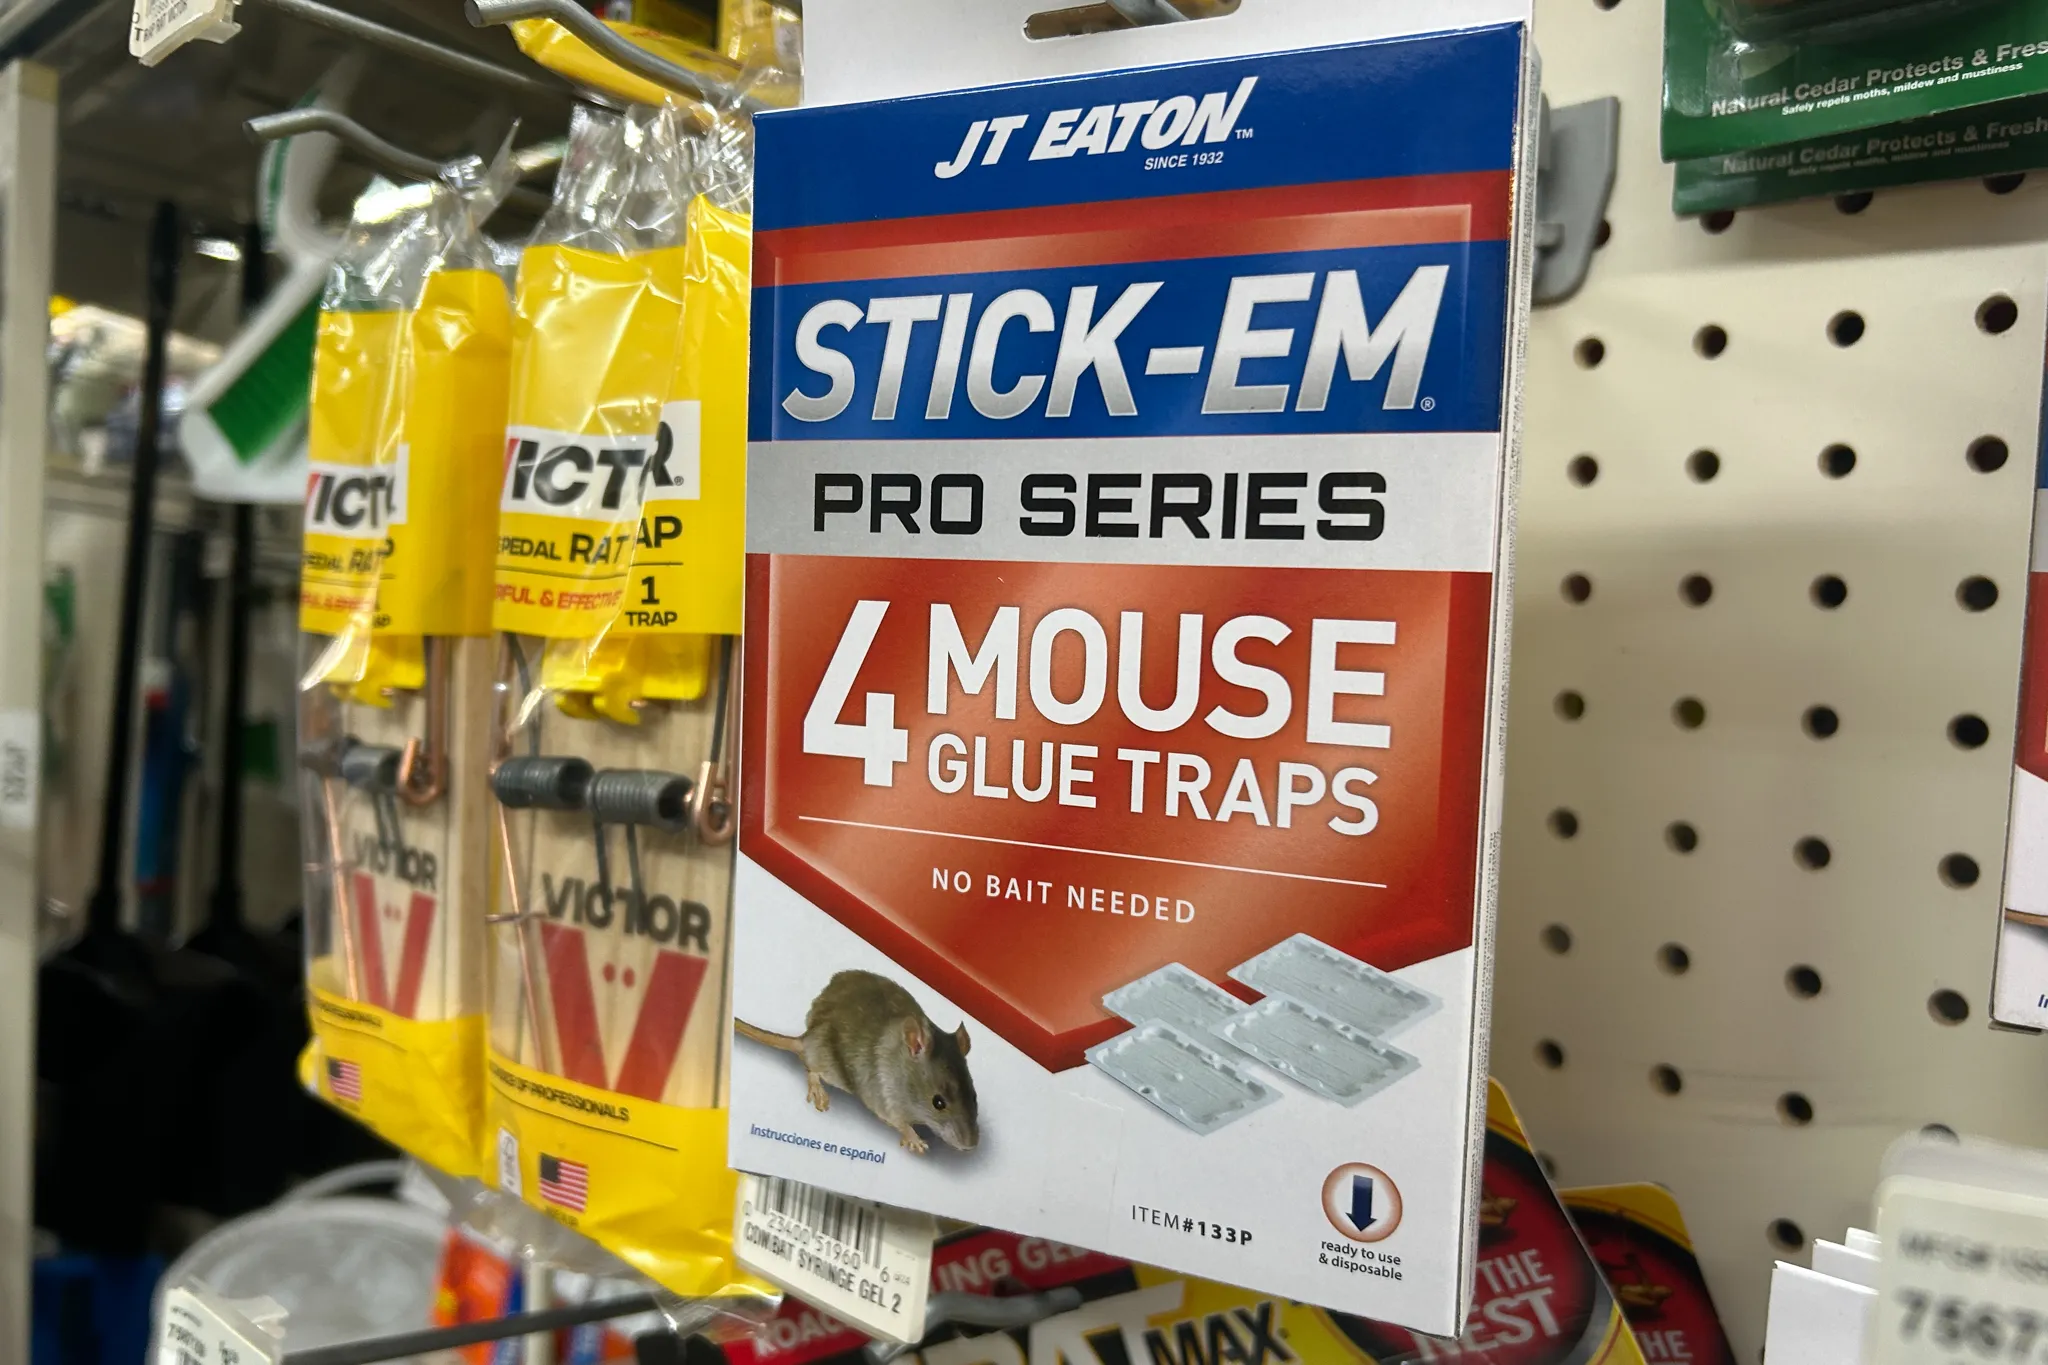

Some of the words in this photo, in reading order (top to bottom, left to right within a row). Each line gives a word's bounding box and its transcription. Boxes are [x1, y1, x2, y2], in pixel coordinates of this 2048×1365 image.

[1711, 86, 1790, 118] Natural
[1794, 76, 1861, 101] Cedar
[1866, 55, 1964, 87] Protects
[1971, 49, 1989, 67] &
[1782, 101, 1815, 116] Safely
[1816, 95, 1851, 110] repels
[1853, 87, 1891, 102] moths,
[1893, 78, 1935, 94] mildew
[1936, 72, 1960, 86] and
[1961, 62, 2024, 81] mustiness
[934, 114, 1030, 179] JT
[1027, 76, 1260, 162] EATON
[1722, 153, 1794, 176] Natural
[1800, 143, 1861, 165] Cedar
[1866, 130, 1956, 155] Protects
[1963, 124, 1980, 142] &
[1144, 153, 1188, 171] SINCE
[1191, 151, 1225, 167] 1932
[813, 471, 984, 537] PRO
[1019, 471, 1387, 542] SERIES
[640, 575, 661, 605] 1
[624, 610, 678, 627] TRAP
[802, 599, 909, 788] 4
[926, 602, 1398, 749] MOUSE
[927, 732, 1098, 809] GLUE
[1117, 749, 1380, 837] TRAPS
[541, 871, 713, 953] VICTOR
[932, 866, 972, 894] NO
[985, 874, 1053, 904] BAIT
[1066, 885, 1196, 925] NEEDED
[750, 1123, 822, 1150] Instrucciones
[823, 1142, 838, 1154] en
[839, 1145, 887, 1165] español
[1131, 1204, 1254, 1247] ITEM#133P
[814, 1231, 862, 1270] 51960
[879, 1265, 891, 1284] 6
[1318, 1252, 1329, 1265] &
[1331, 1254, 1403, 1282] disposable
[1321, 1239, 1358, 1258] ready
[1361, 1247, 1375, 1261] to
[1378, 1252, 1402, 1267] use
[1477, 1248, 1554, 1294] THE
[798, 1247, 857, 1294] SYRINGE
[858, 1278, 888, 1309] GEL
[891, 1292, 903, 1315] 2
